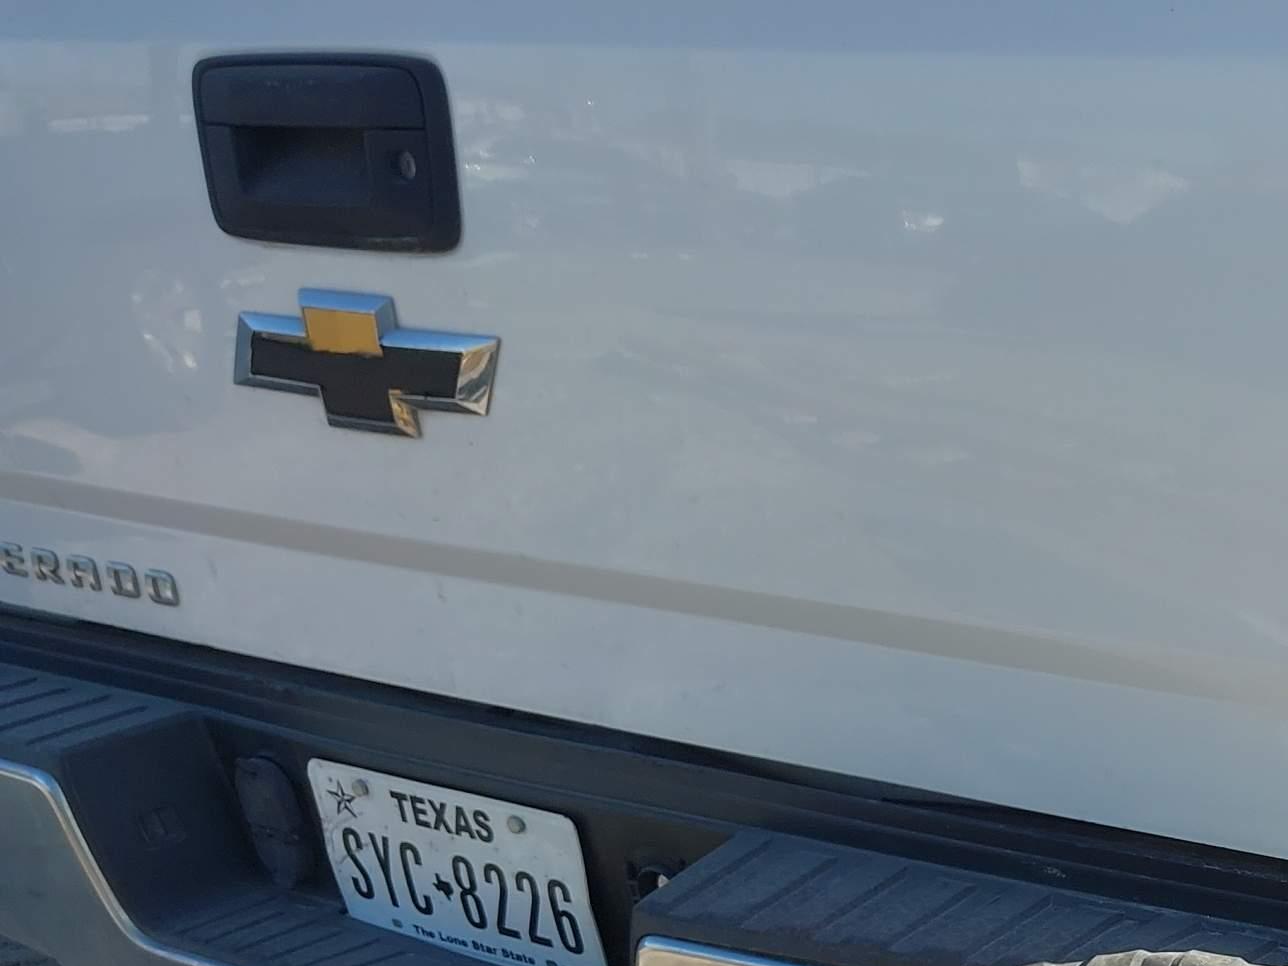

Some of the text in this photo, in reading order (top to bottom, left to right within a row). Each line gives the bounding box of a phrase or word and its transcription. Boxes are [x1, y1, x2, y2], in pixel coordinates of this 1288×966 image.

[390, 790, 494, 843] TEXAS
[413, 924, 536, 965] The Lone Star State
